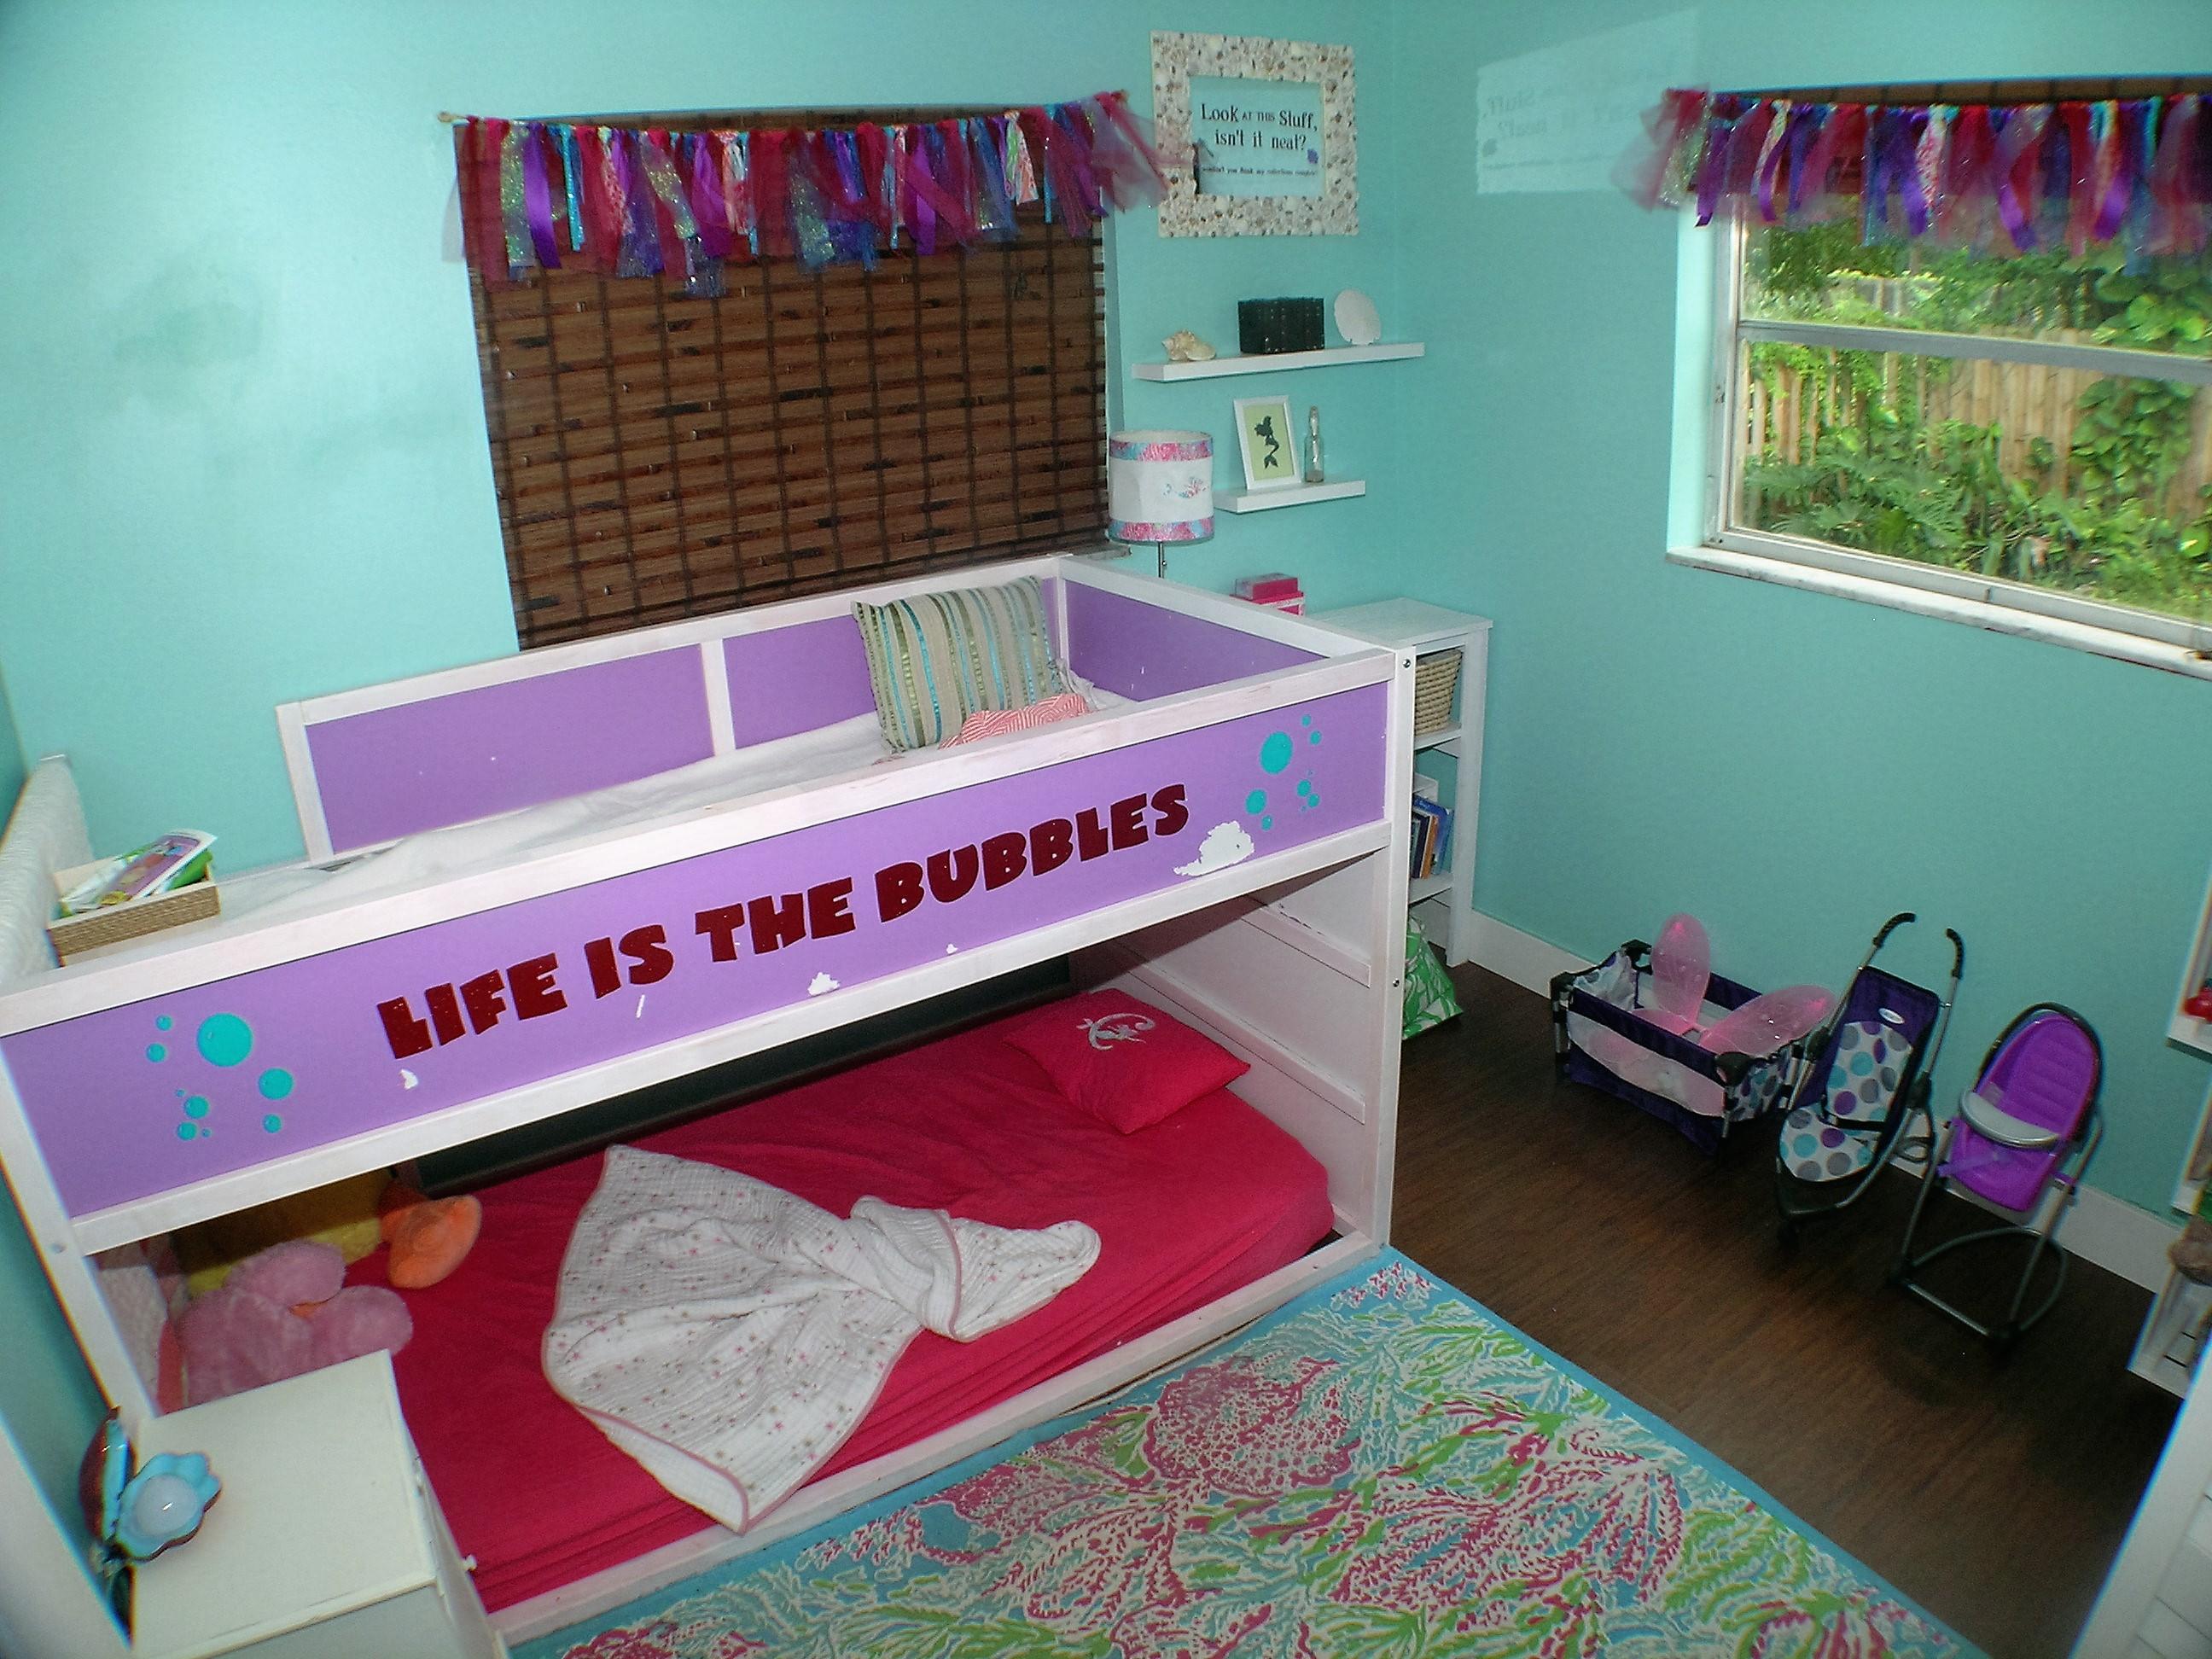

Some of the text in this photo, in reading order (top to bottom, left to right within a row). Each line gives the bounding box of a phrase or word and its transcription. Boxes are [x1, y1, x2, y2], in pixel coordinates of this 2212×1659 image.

[1215, 129, 1244, 147] isn't
[1253, 131, 1262, 148] it
[377, 783, 1189, 1059] LIFE IS THE BUBBLES
